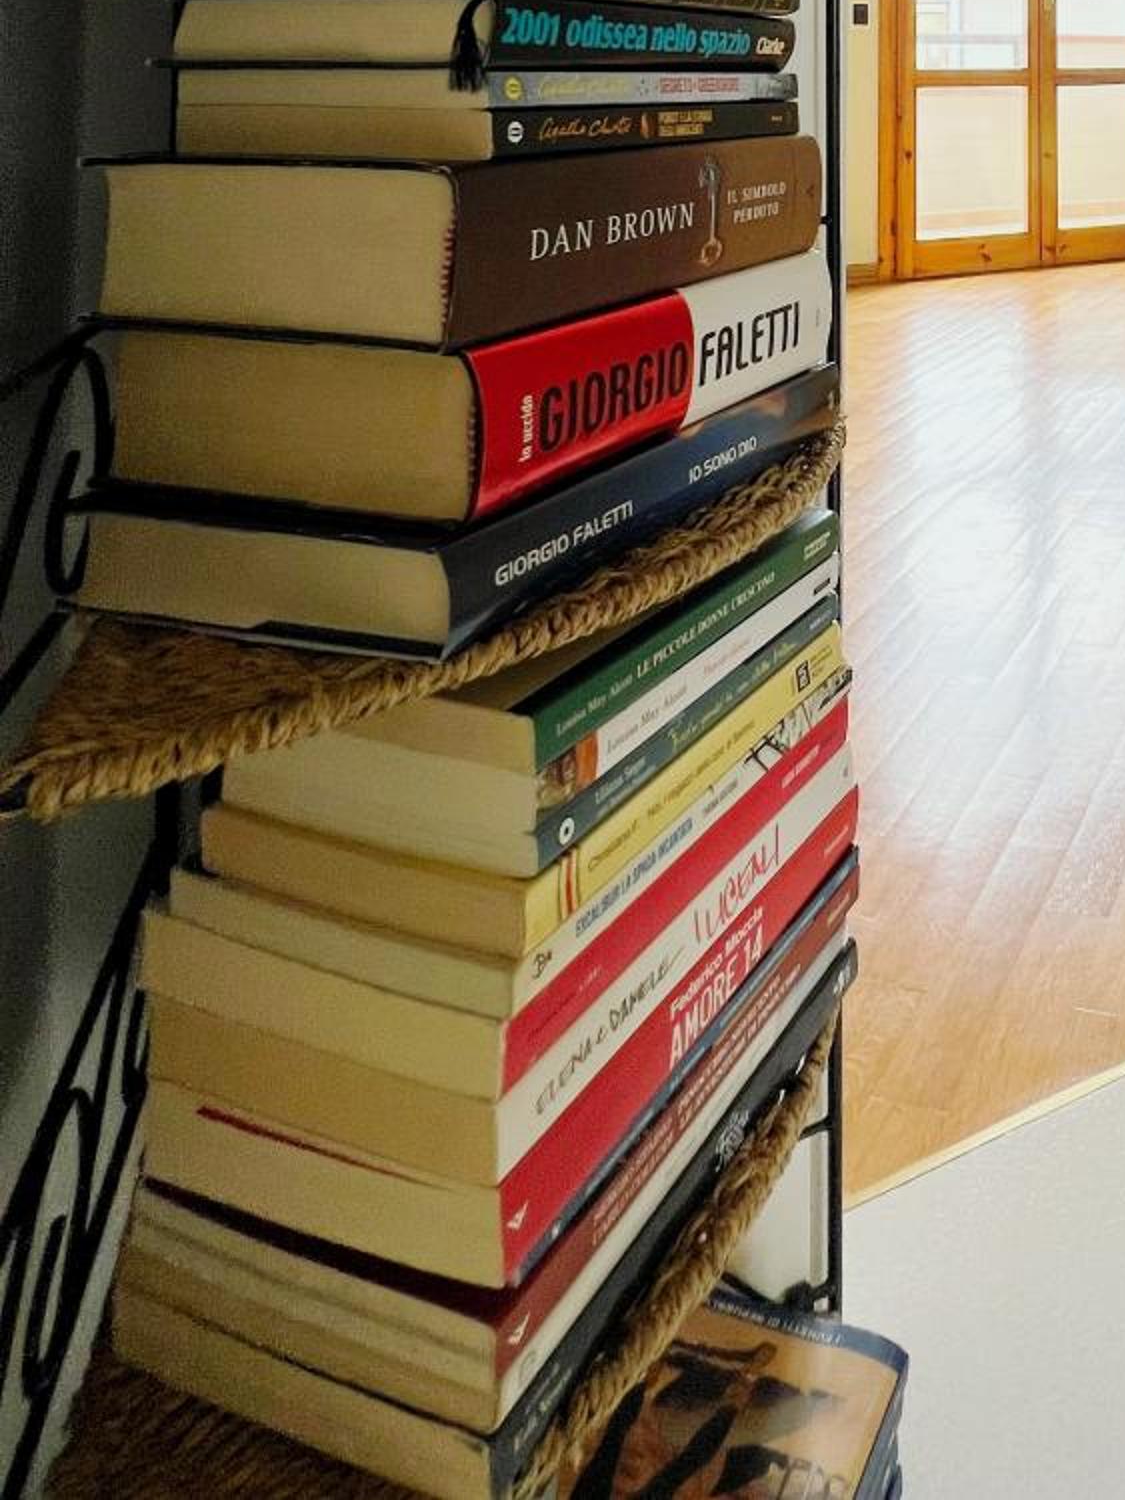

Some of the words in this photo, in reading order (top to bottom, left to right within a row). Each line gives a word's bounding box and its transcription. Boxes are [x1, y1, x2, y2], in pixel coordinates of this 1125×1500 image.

[500, 7, 561, 46] 2001
[565, 14, 648, 51] odissea
[650, 23, 697, 54] nello
[699, 26, 750, 59] spazio
[727, 187, 739, 206] IL
[742, 180, 787, 203] SIMBOLO
[732, 200, 780, 225] PERDUTO
[529, 218, 593, 261] DAN
[605, 201, 695, 246] BROWN
[539, 340, 689, 454] GIORGIO
[698, 301, 801, 388] FALETTI
[688, 466, 703, 485] IO
[703, 445, 737, 478] SONO
[737, 435, 758, 459] DIO
[494, 535, 571, 587] GIORGIO
[572, 499, 635, 547] FALETTI
[636, 661, 652, 680] LE
[652, 627, 698, 668] PICCOLE
[669, 954, 724, 1016] Federico
[724, 904, 764, 958] Moccia
[669, 951, 739, 1072] AMORE
[743, 922, 763, 975] 14
